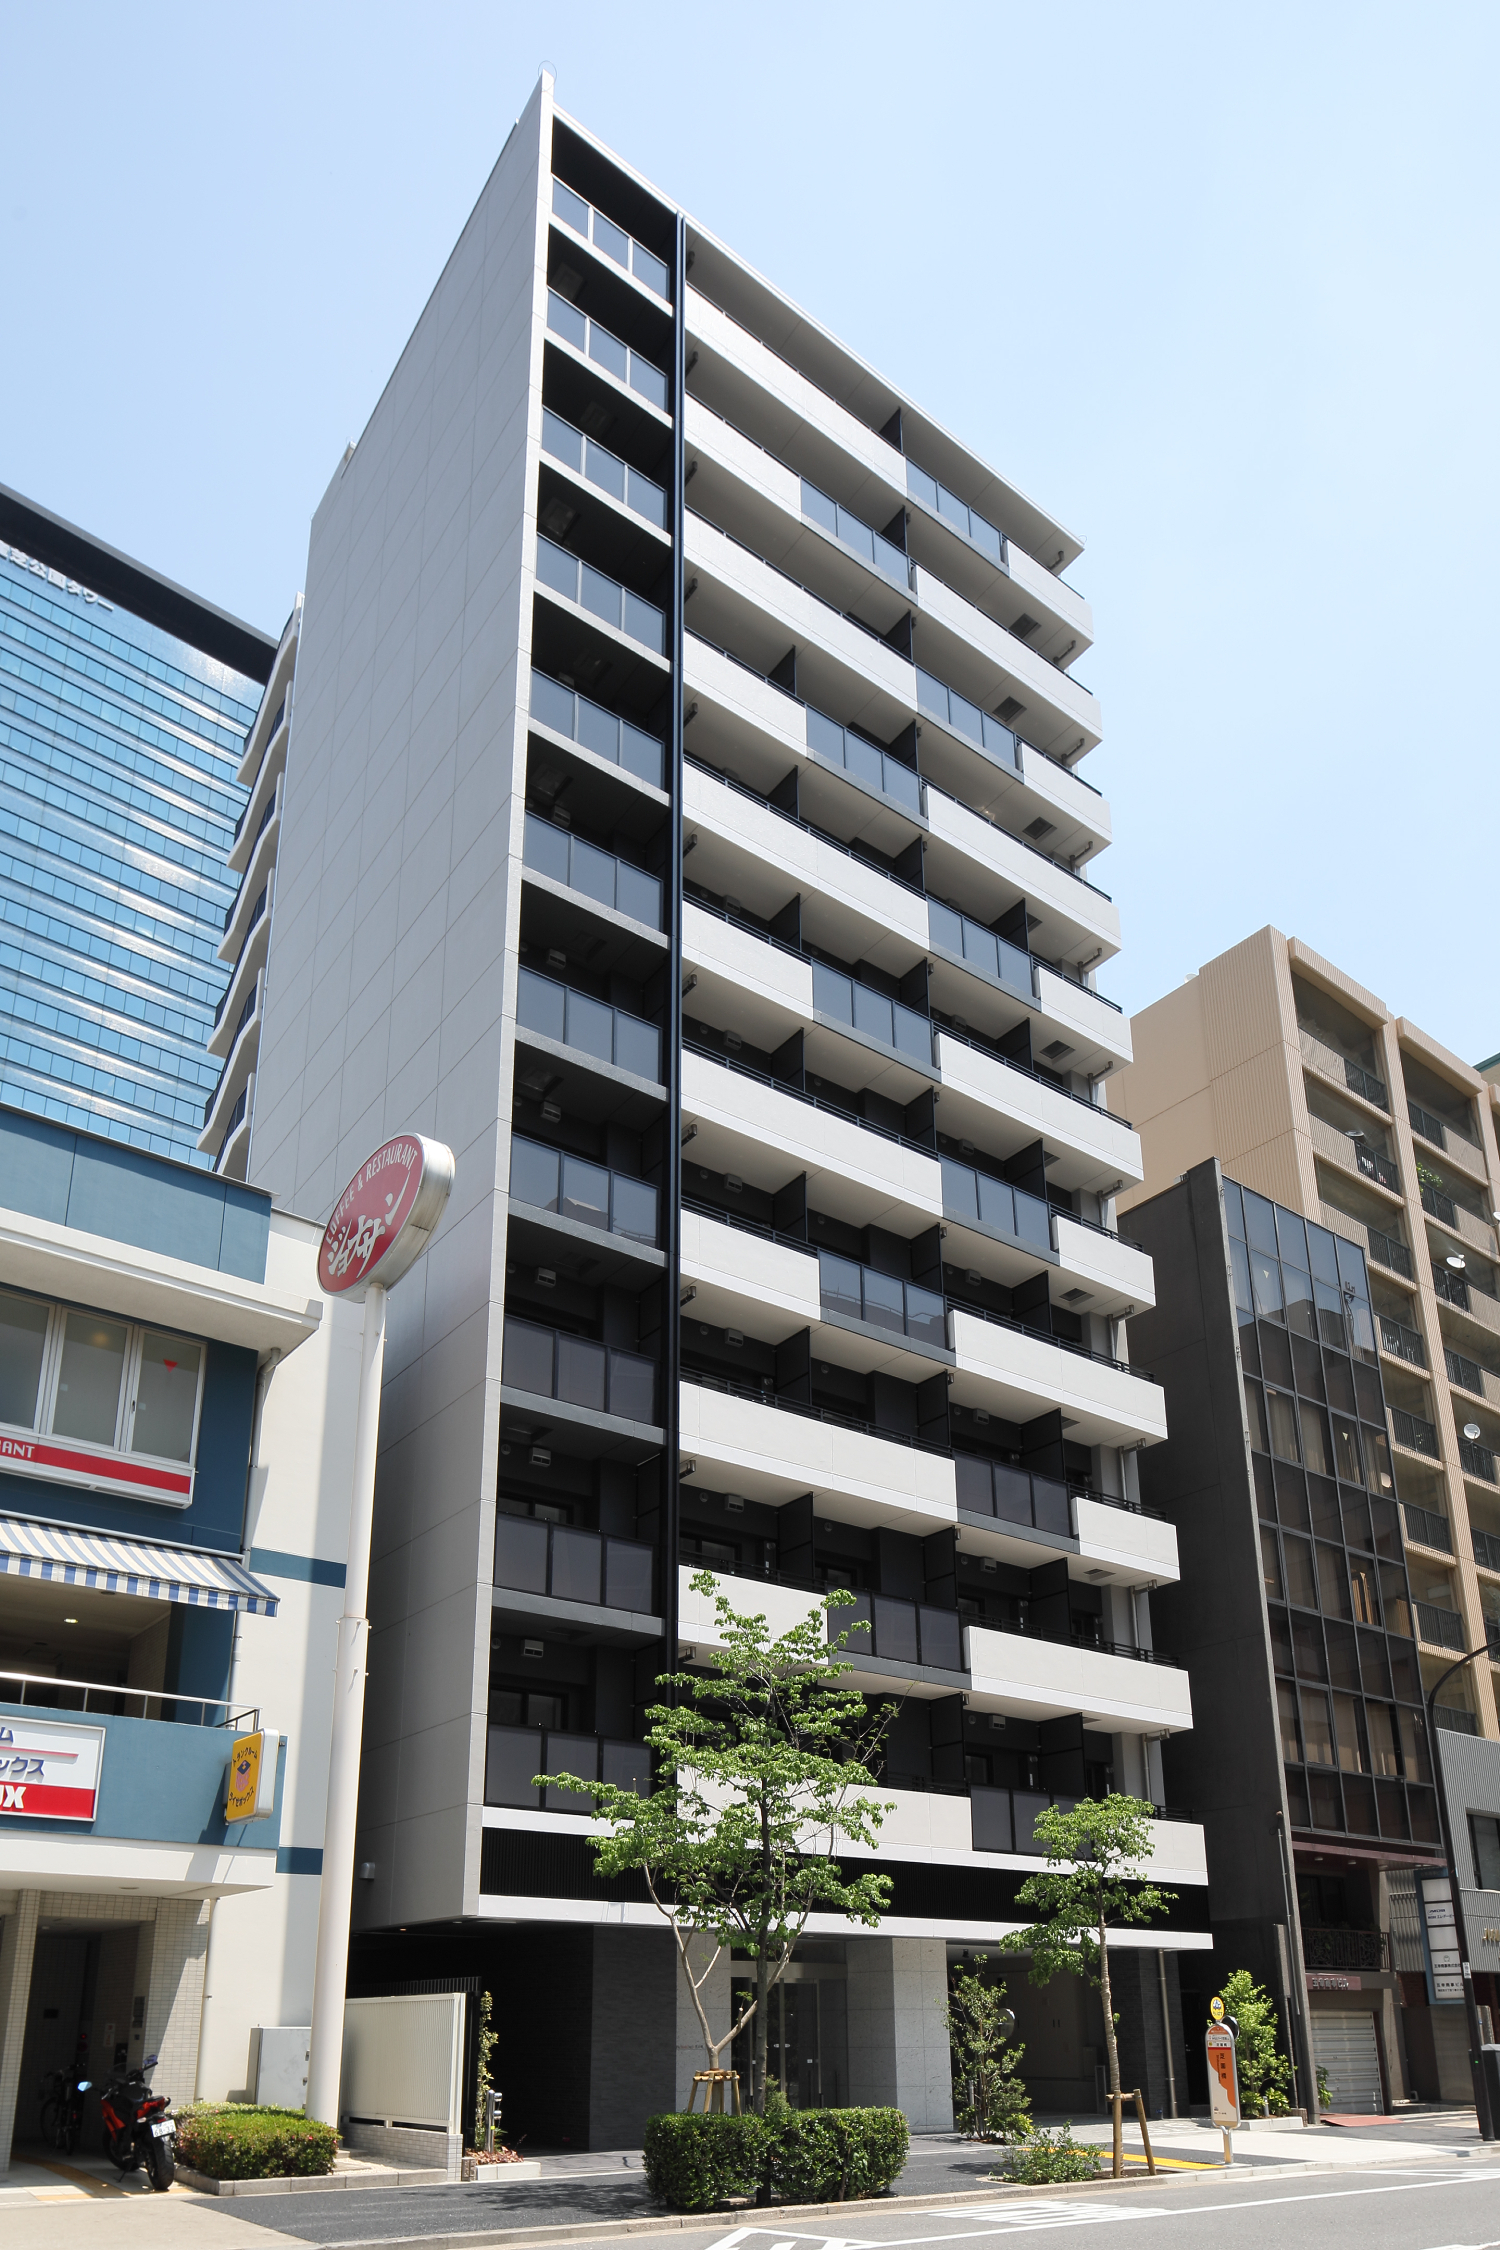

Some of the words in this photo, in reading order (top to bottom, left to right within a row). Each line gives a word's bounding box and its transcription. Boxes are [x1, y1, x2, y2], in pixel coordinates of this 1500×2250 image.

[325, 1186, 355, 1245] COFFEE
[357, 1174, 364, 1192] &
[366, 1143, 418, 1182] RESTAURANT
[326, 1170, 411, 1279] ジョナサン
[0, 1440, 35, 1458] ANT
[0, 1784, 27, 1809] X
